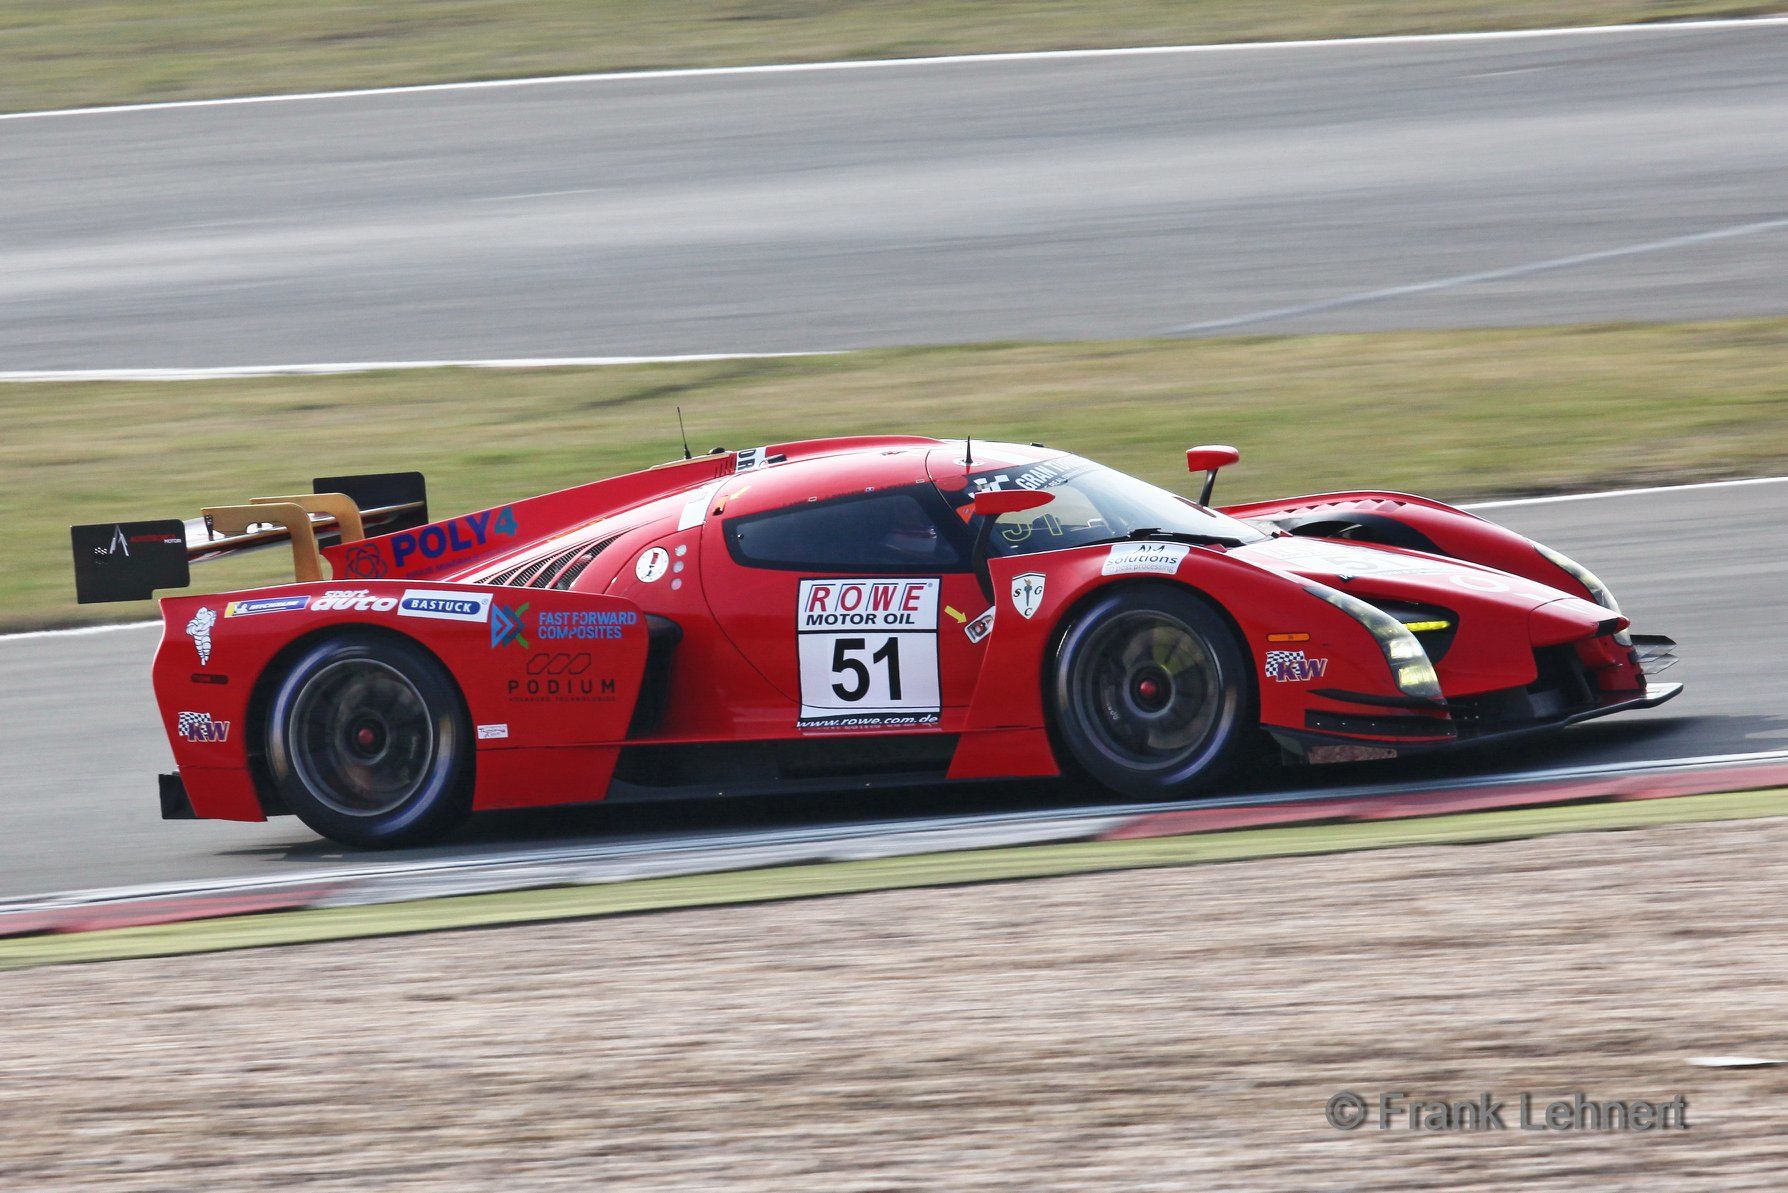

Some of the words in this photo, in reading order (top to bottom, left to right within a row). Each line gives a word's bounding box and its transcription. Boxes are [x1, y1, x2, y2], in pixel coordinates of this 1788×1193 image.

[1015, 465, 1058, 490] GRAN
[1107, 555, 1178, 566] solutions
[322, 589, 369, 602] sport
[806, 583, 926, 613] ROWE
[310, 595, 397, 612] auto
[410, 599, 472, 613] BASTUCK
[538, 611, 570, 625] FAST
[572, 611, 637, 625] FORWARD
[806, 613, 876, 626] MOTOR
[883, 613, 915, 625] OIL
[537, 626, 622, 639] COMPOSITES
[831, 636, 902, 702] 51
[1276, 658, 1328, 682] KW
[508, 679, 616, 694] PODIUM
[796, 713, 938, 728] www.rowe.com.de
[187, 721, 230, 742] KW
